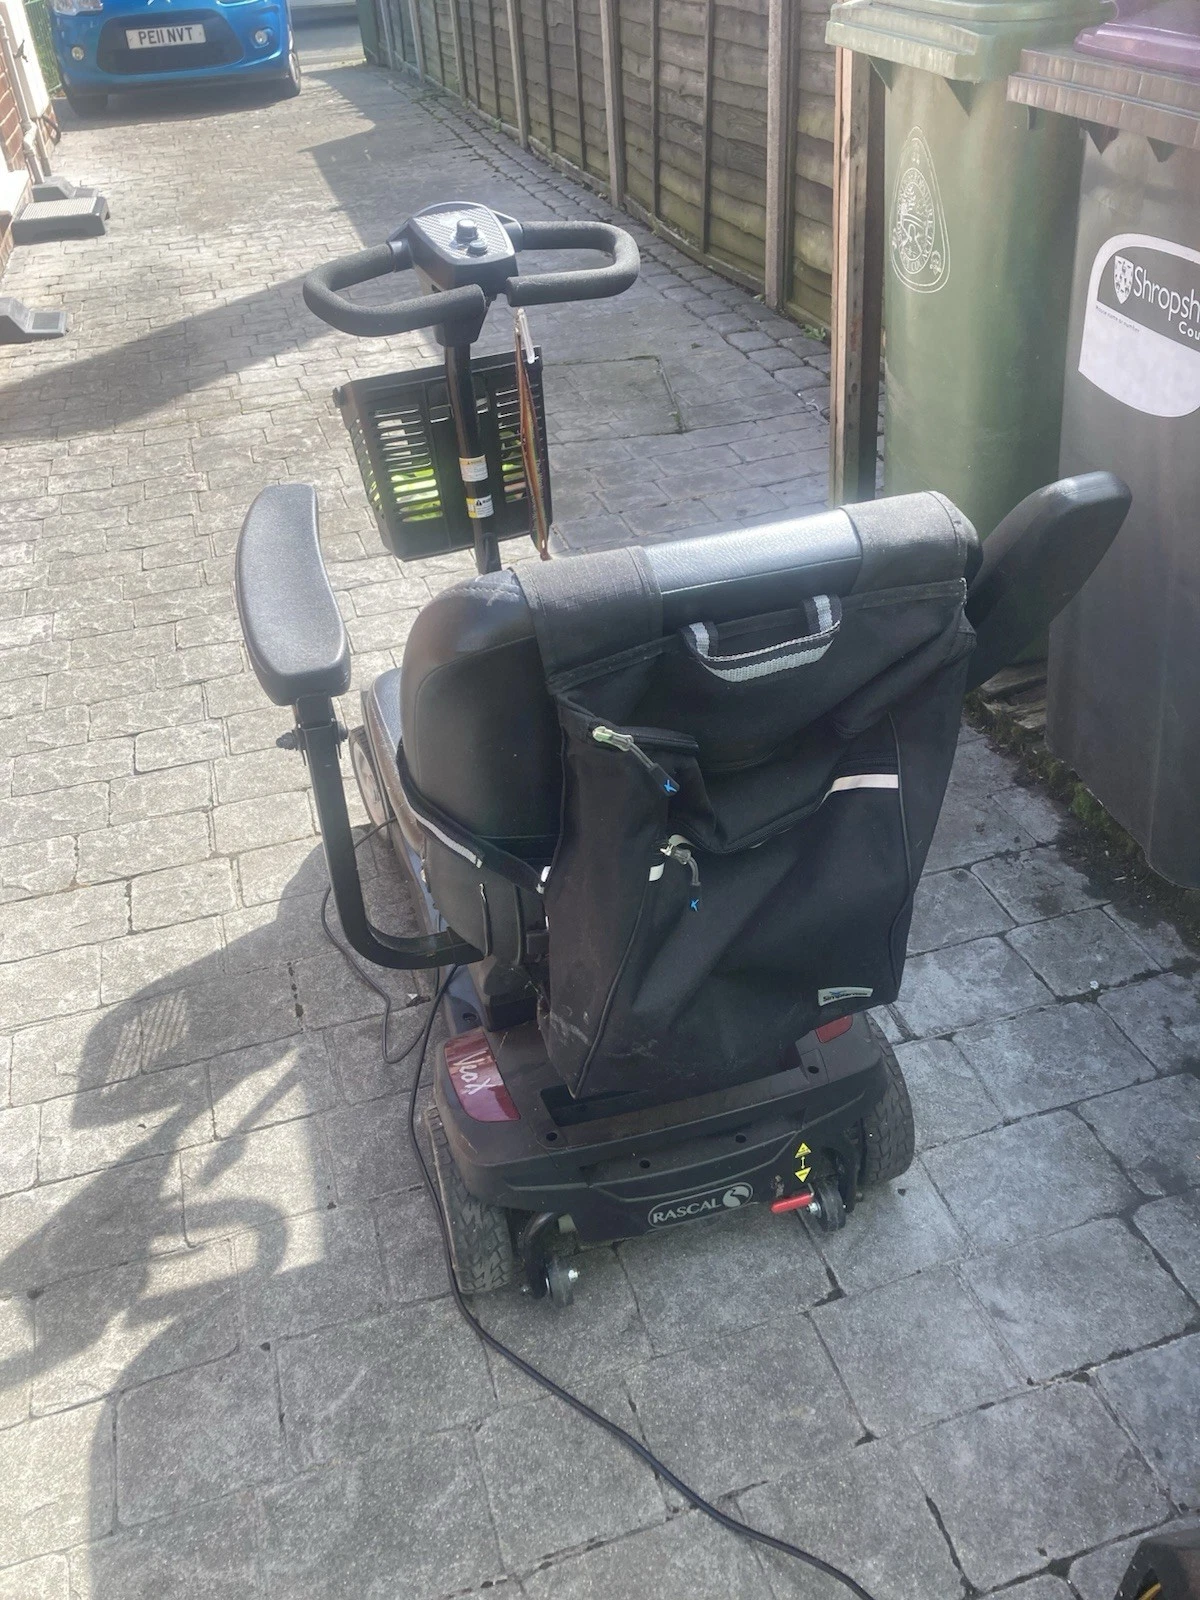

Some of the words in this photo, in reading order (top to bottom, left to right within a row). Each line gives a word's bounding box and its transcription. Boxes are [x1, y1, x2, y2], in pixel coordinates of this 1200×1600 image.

[138, 29, 165, 45] PE11
[167, 27, 193, 43] NVT
[1133, 266, 1200, 323] Shropsh
[653, 1198, 721, 1223] RASCAL
